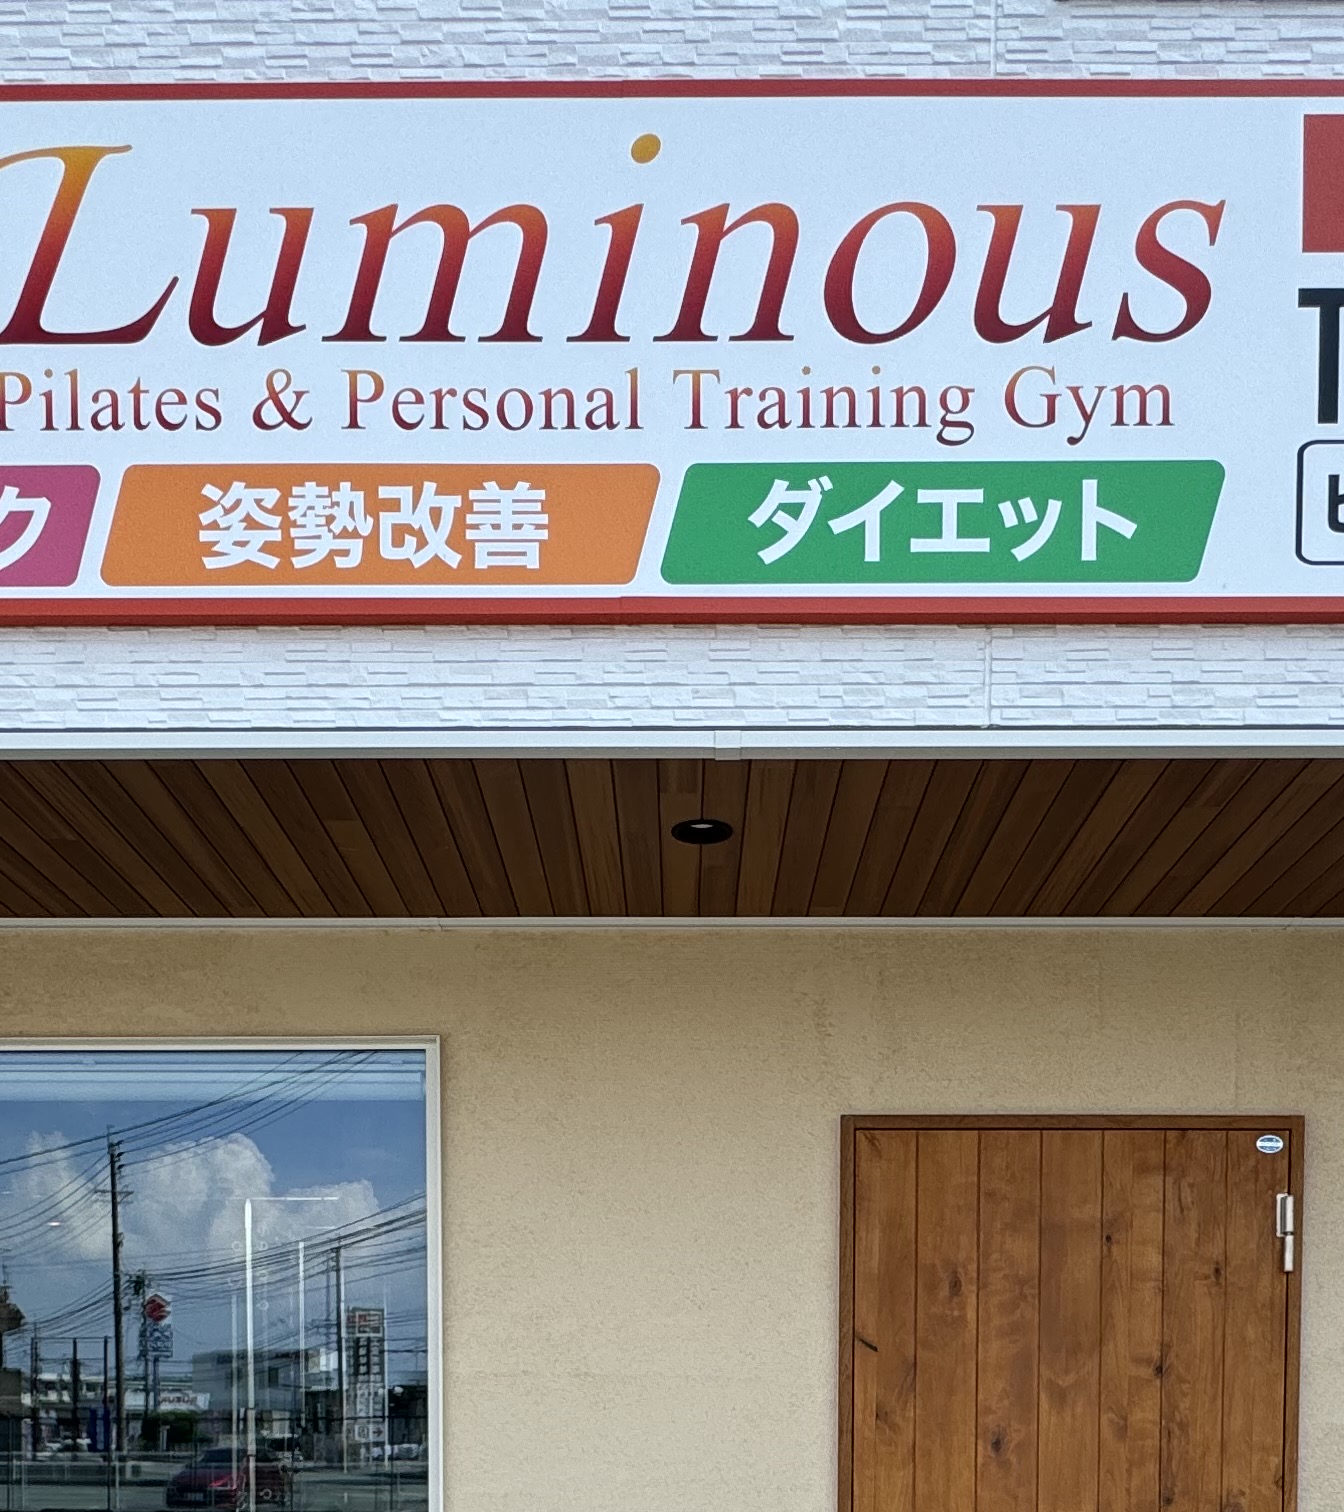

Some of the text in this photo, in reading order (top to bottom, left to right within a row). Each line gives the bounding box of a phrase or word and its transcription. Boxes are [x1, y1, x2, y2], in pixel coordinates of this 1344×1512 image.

[252, 368, 313, 433] &
[340, 366, 643, 432] Personal
[672, 364, 977, 447] Training
[1003, 364, 1176, 447] Gym
[197, 481, 550, 570] 姿勢改善
[747, 474, 1138, 564] ダイエット
